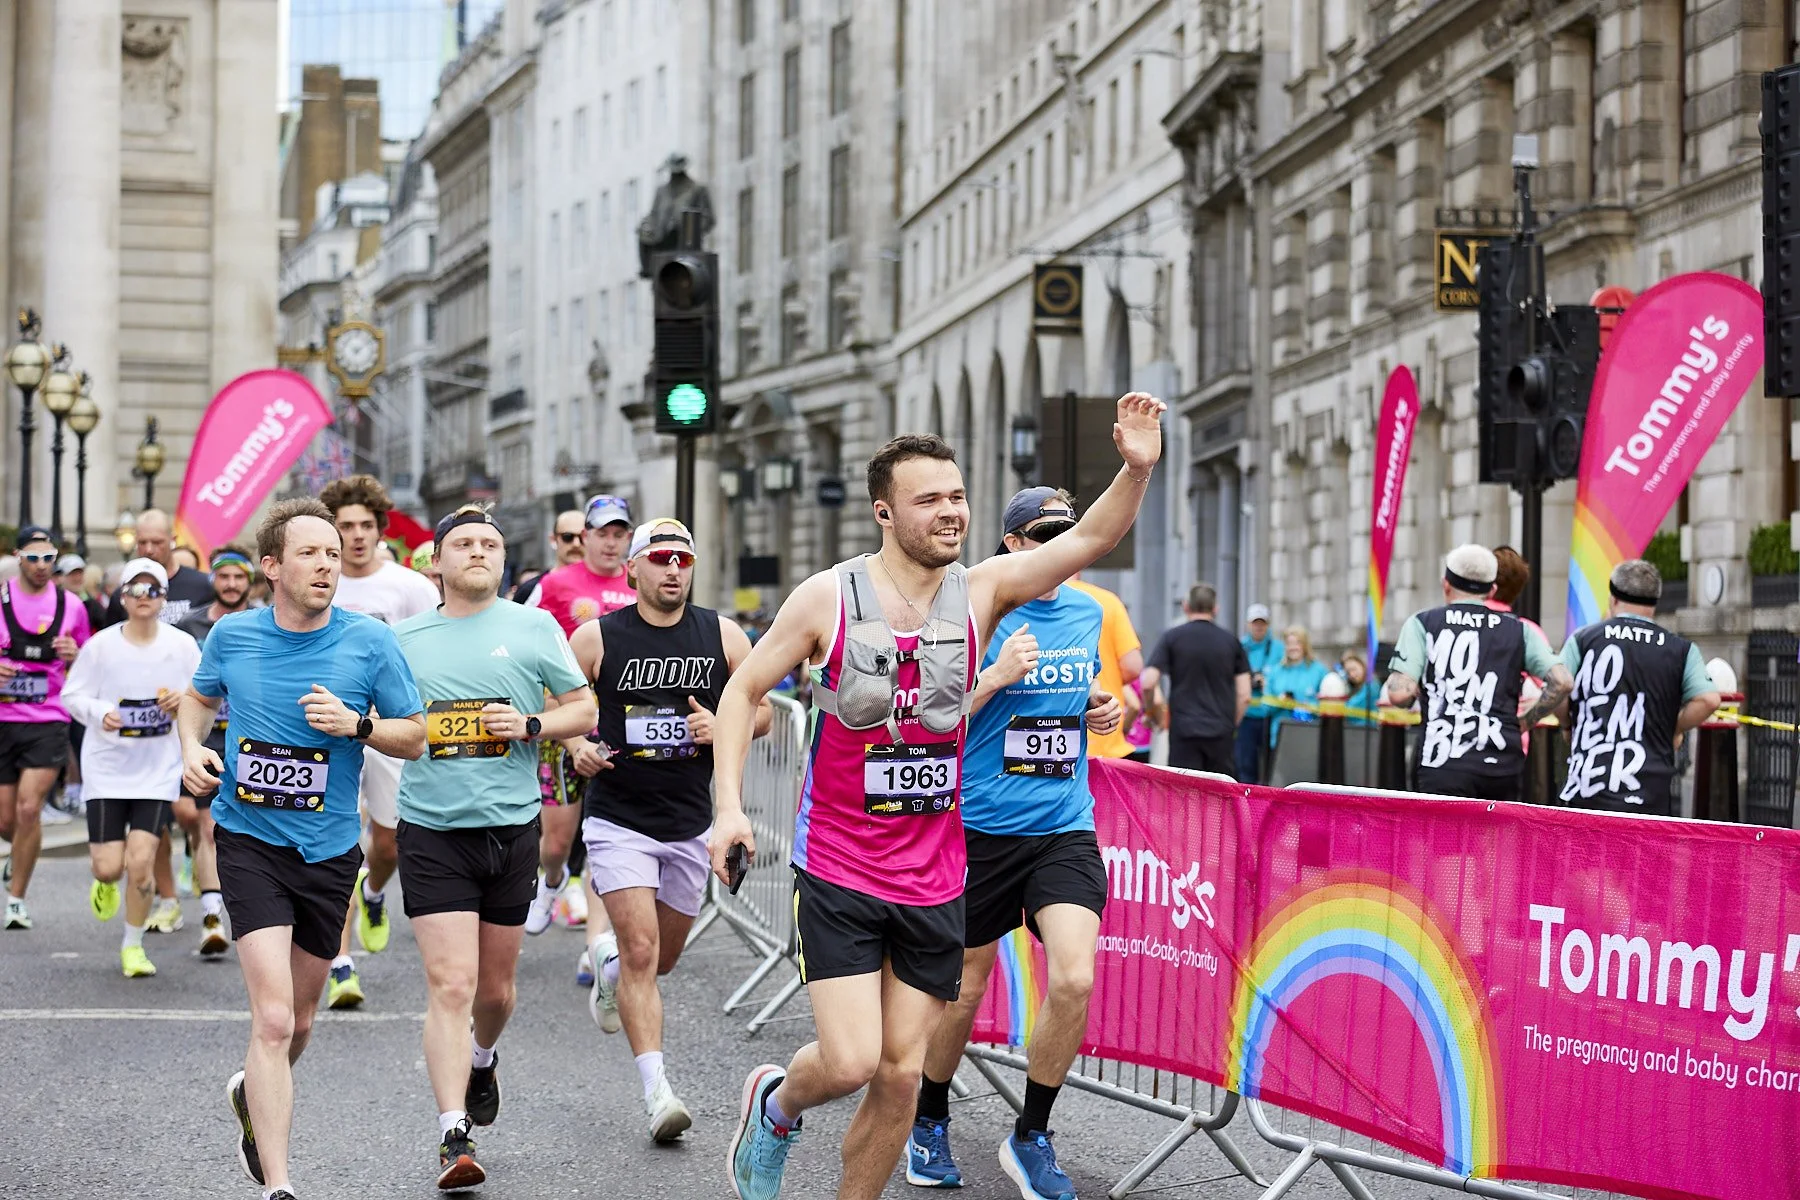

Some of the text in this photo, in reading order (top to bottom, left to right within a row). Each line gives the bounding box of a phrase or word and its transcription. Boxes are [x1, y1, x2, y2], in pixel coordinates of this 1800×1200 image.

[1604, 315, 1730, 476] Tommy's
[1642, 333, 1754, 494] The pregnancy and baby charity
[196, 398, 294, 507] Tommy's
[1376, 397, 1408, 530] Tommy's
[1445, 610, 1501, 628] MAT P
[1604, 624, 1665, 646] MATT J
[1037, 646, 1088, 660] supporting
[617, 657, 715, 691] ADDIX
[1024, 661, 1094, 685] ROST8
[453, 701, 485, 709] MANLEY
[439, 716, 494, 737] 321
[645, 722, 686, 741] 535
[1037, 719, 1061, 727] CALLUM
[271, 747, 292, 756] SEAN
[908, 747, 927, 756] TOM
[1026, 734, 1067, 755] 913
[1421, 710, 1507, 768] BER
[247, 760, 313, 788] 2023
[883, 763, 948, 790] 1963
[1559, 739, 1646, 802] BER
[1102, 846, 1216, 929] mmy's
[1096, 935, 1128, 958] nancy
[1180, 944, 1218, 977] charity
[1529, 903, 1800, 1041] Tommy'
[1523, 1023, 1800, 1092] The pregnancy and baby char
